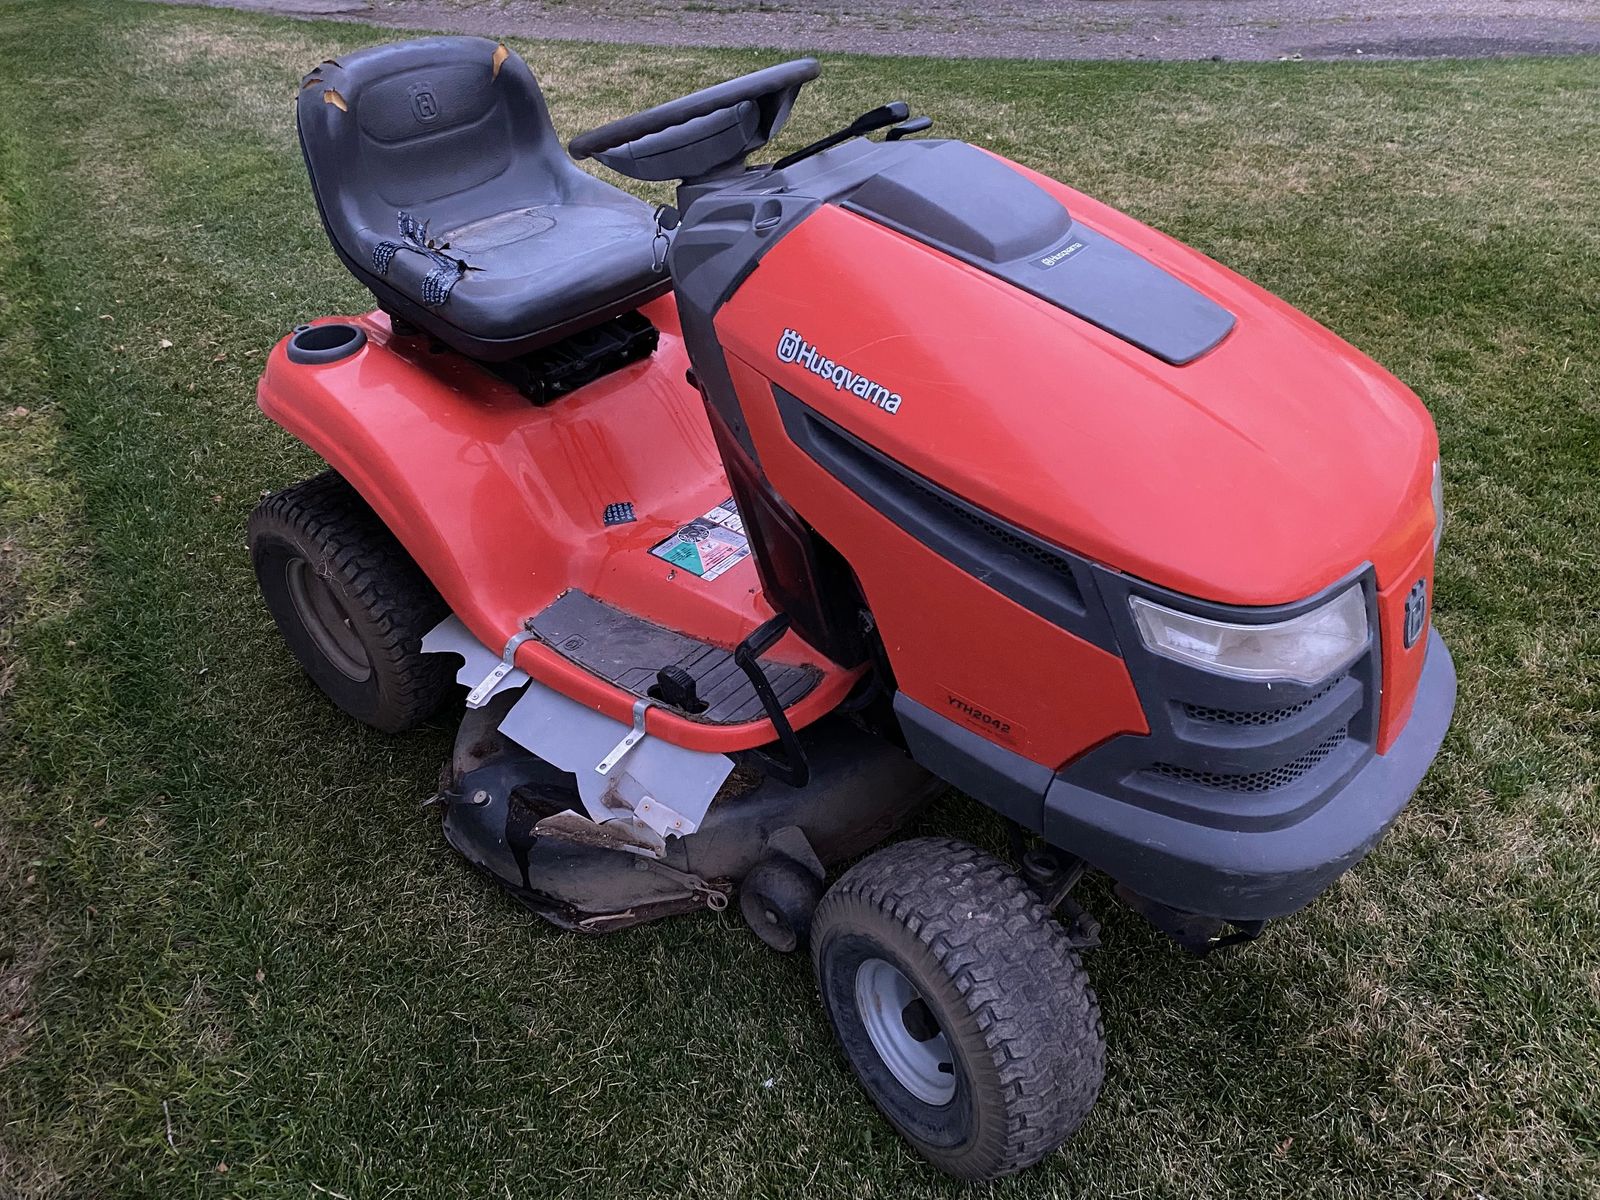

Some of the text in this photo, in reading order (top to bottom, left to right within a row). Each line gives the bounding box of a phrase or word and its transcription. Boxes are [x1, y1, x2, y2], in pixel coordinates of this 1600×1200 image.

[1048, 243, 1082, 262] Husqvarna
[796, 341, 902, 415] Husqvarna
[947, 695, 1011, 734] YTH2042
